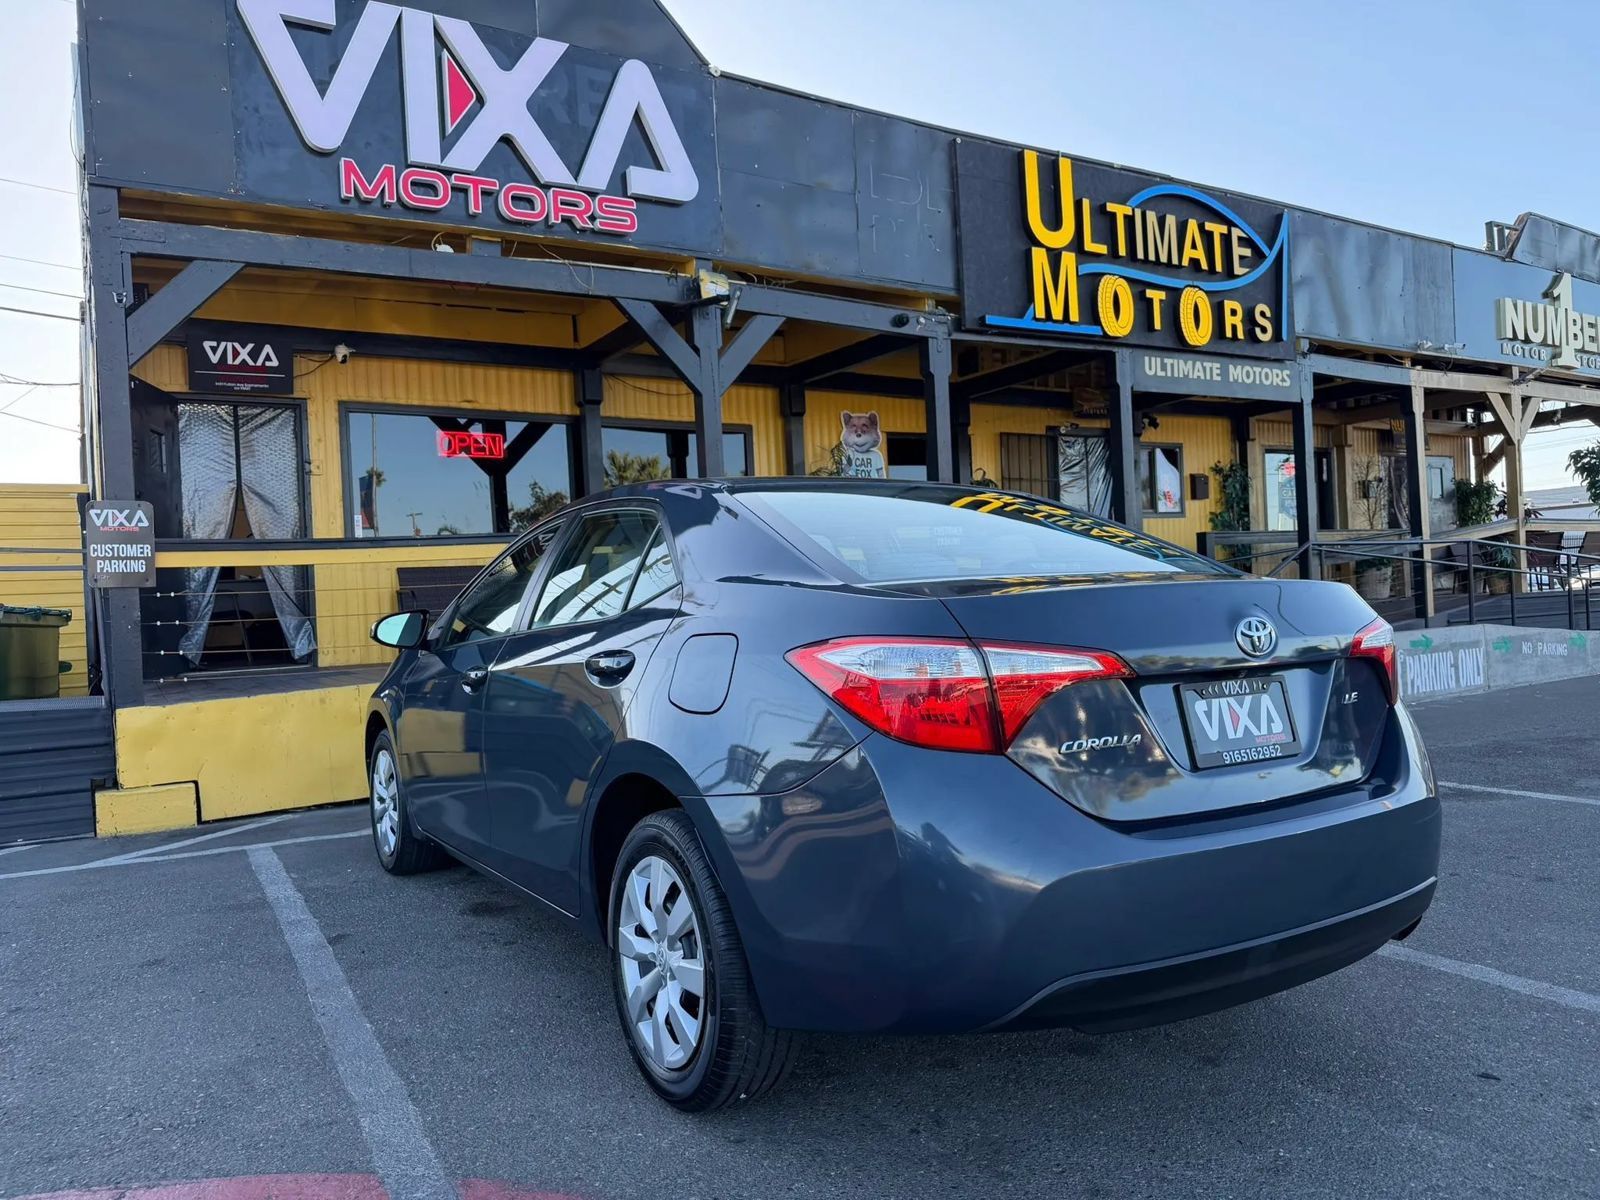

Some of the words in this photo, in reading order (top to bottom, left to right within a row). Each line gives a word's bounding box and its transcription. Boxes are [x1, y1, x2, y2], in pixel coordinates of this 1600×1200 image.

[237, 0, 699, 203] VIXA
[340, 158, 638, 234] MOTORS
[1022, 149, 1252, 276] ULTIMATE
[1030, 246, 1273, 347] MOTORS
[1498, 297, 1600, 353] NUMBE
[203, 340, 280, 367] VIXA
[1501, 343, 1547, 361] MOTOR
[1144, 356, 1222, 381] ULTIMATE
[1228, 364, 1291, 387] MOTORS
[439, 433, 502, 457] OPEN
[854, 457, 873, 469] CAR
[855, 468, 872, 478] FOX
[89, 509, 150, 527] VIXA
[89, 543, 152, 558] CUSTOMER
[96, 559, 146, 573] PARKING
[1521, 640, 1533, 655] NO
[1537, 642, 1569, 657] PARKING
[1405, 649, 1457, 696] PARKING
[1457, 646, 1485, 688] ONLY
[1221, 679, 1251, 696] VIXA
[1343, 691, 1359, 705] LE
[1194, 693, 1284, 742] VIXA
[1059, 733, 1142, 754] COROLLA
[1222, 744, 1283, 764] 9165162952
